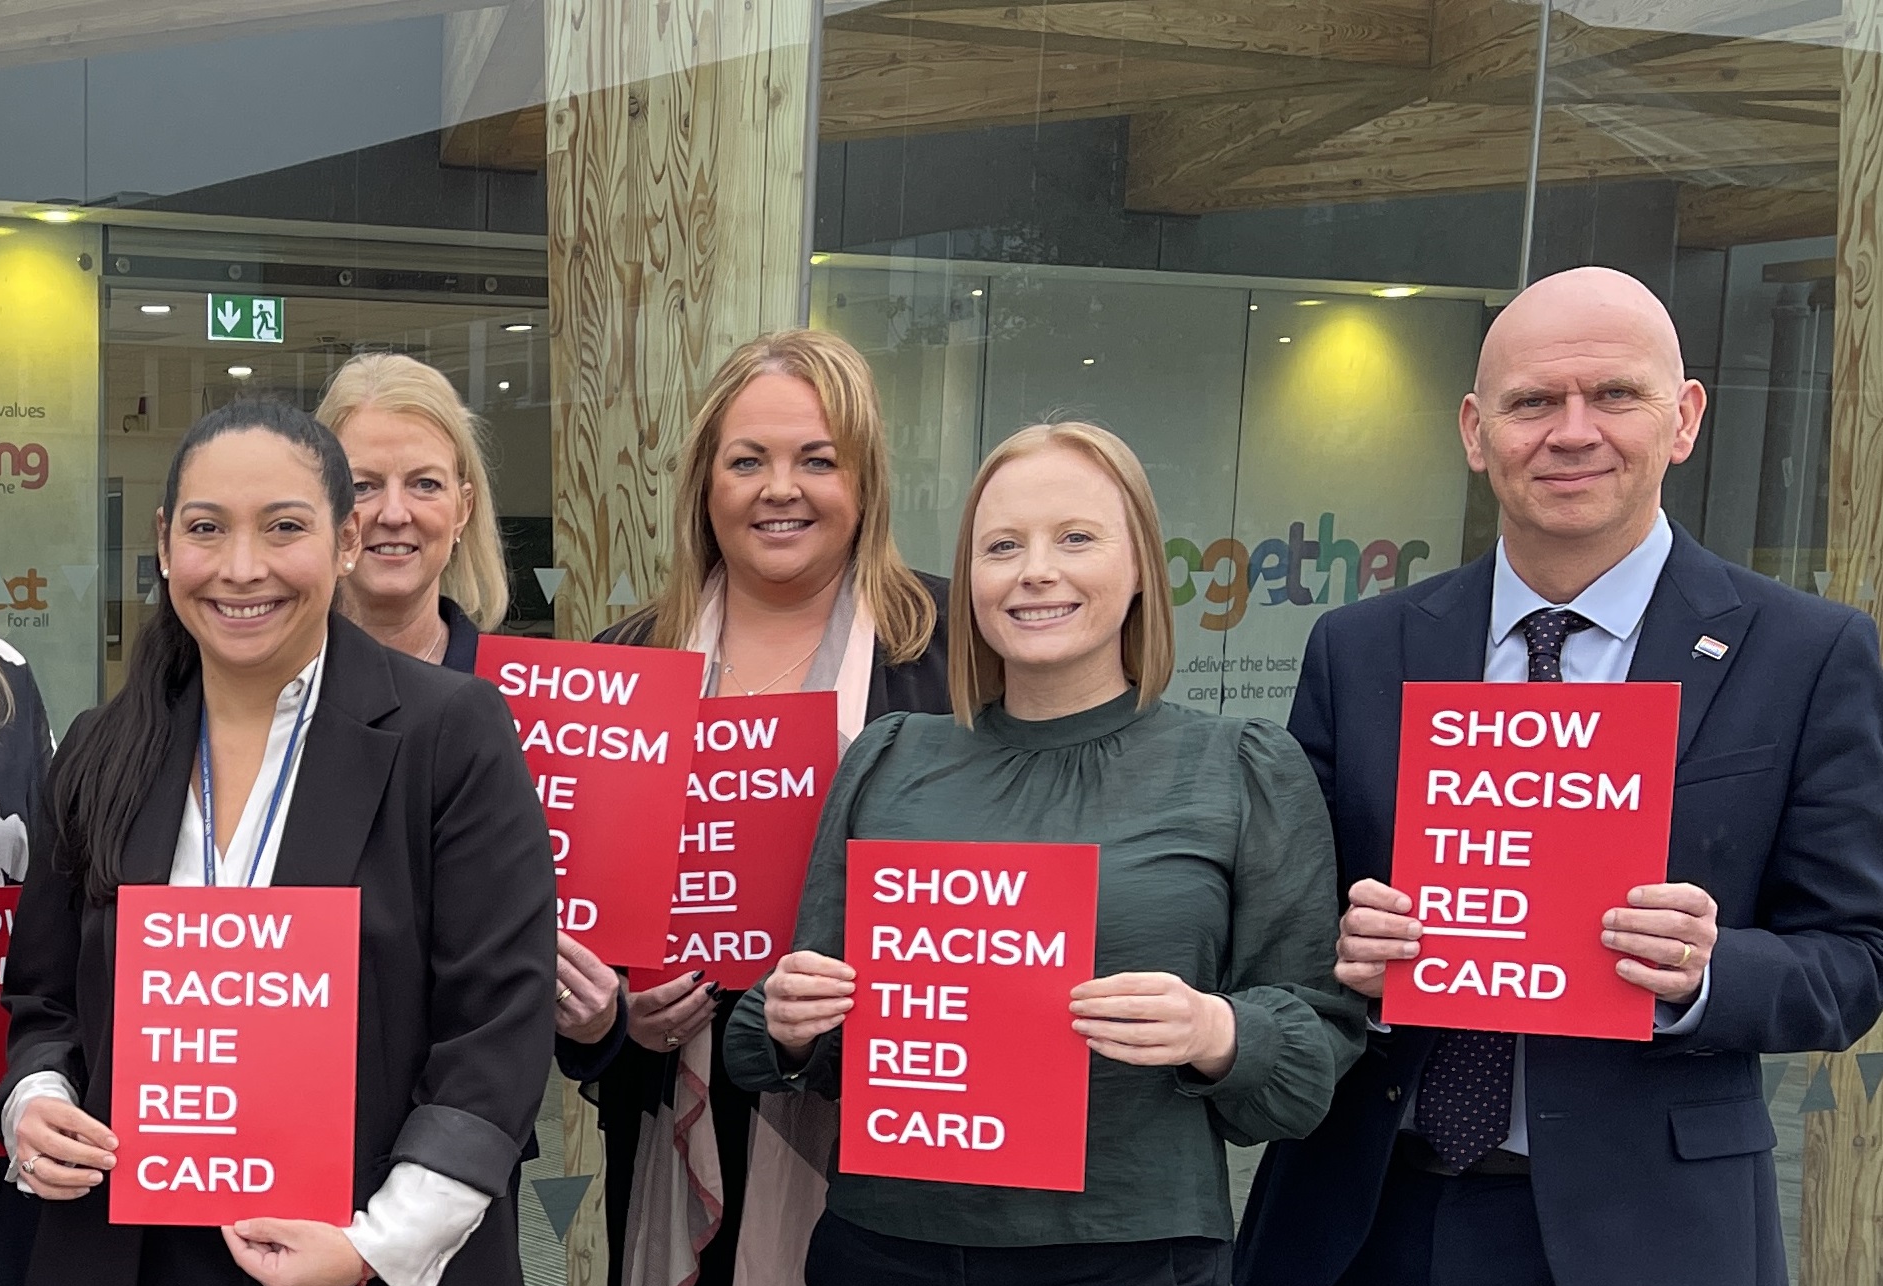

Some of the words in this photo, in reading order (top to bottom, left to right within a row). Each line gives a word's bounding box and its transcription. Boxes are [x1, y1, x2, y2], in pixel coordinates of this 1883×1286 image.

[1165, 512, 1430, 631] ogether
[7, 613, 29, 627] for
[33, 613, 49, 627] all
[1239, 655, 1262, 672] the
[1266, 654, 1297, 672] best
[499, 663, 639, 705] SHOW
[1187, 686, 1218, 700] care
[1241, 681, 1264, 699] the
[514, 720, 668, 763] ACISM
[1430, 711, 1600, 747] SHOW
[687, 767, 813, 802] ACISM
[1427, 770, 1640, 810] RACISM
[679, 821, 735, 853] HE
[1425, 829, 1532, 866] THE
[672, 871, 736, 902] ED
[873, 868, 1027, 905] SHOW
[1419, 886, 1528, 925] RED
[143, 913, 291, 948] SHOW
[872, 926, 1065, 966] RACISM
[143, 971, 328, 1007] RACISM
[1414, 958, 1566, 999] CARD
[872, 983, 968, 1021] THE
[142, 1028, 237, 1063] THE
[870, 1039, 967, 1077] RED
[139, 1085, 236, 1120] RED
[868, 1109, 1004, 1150] CARD
[138, 1156, 274, 1192] CARD
